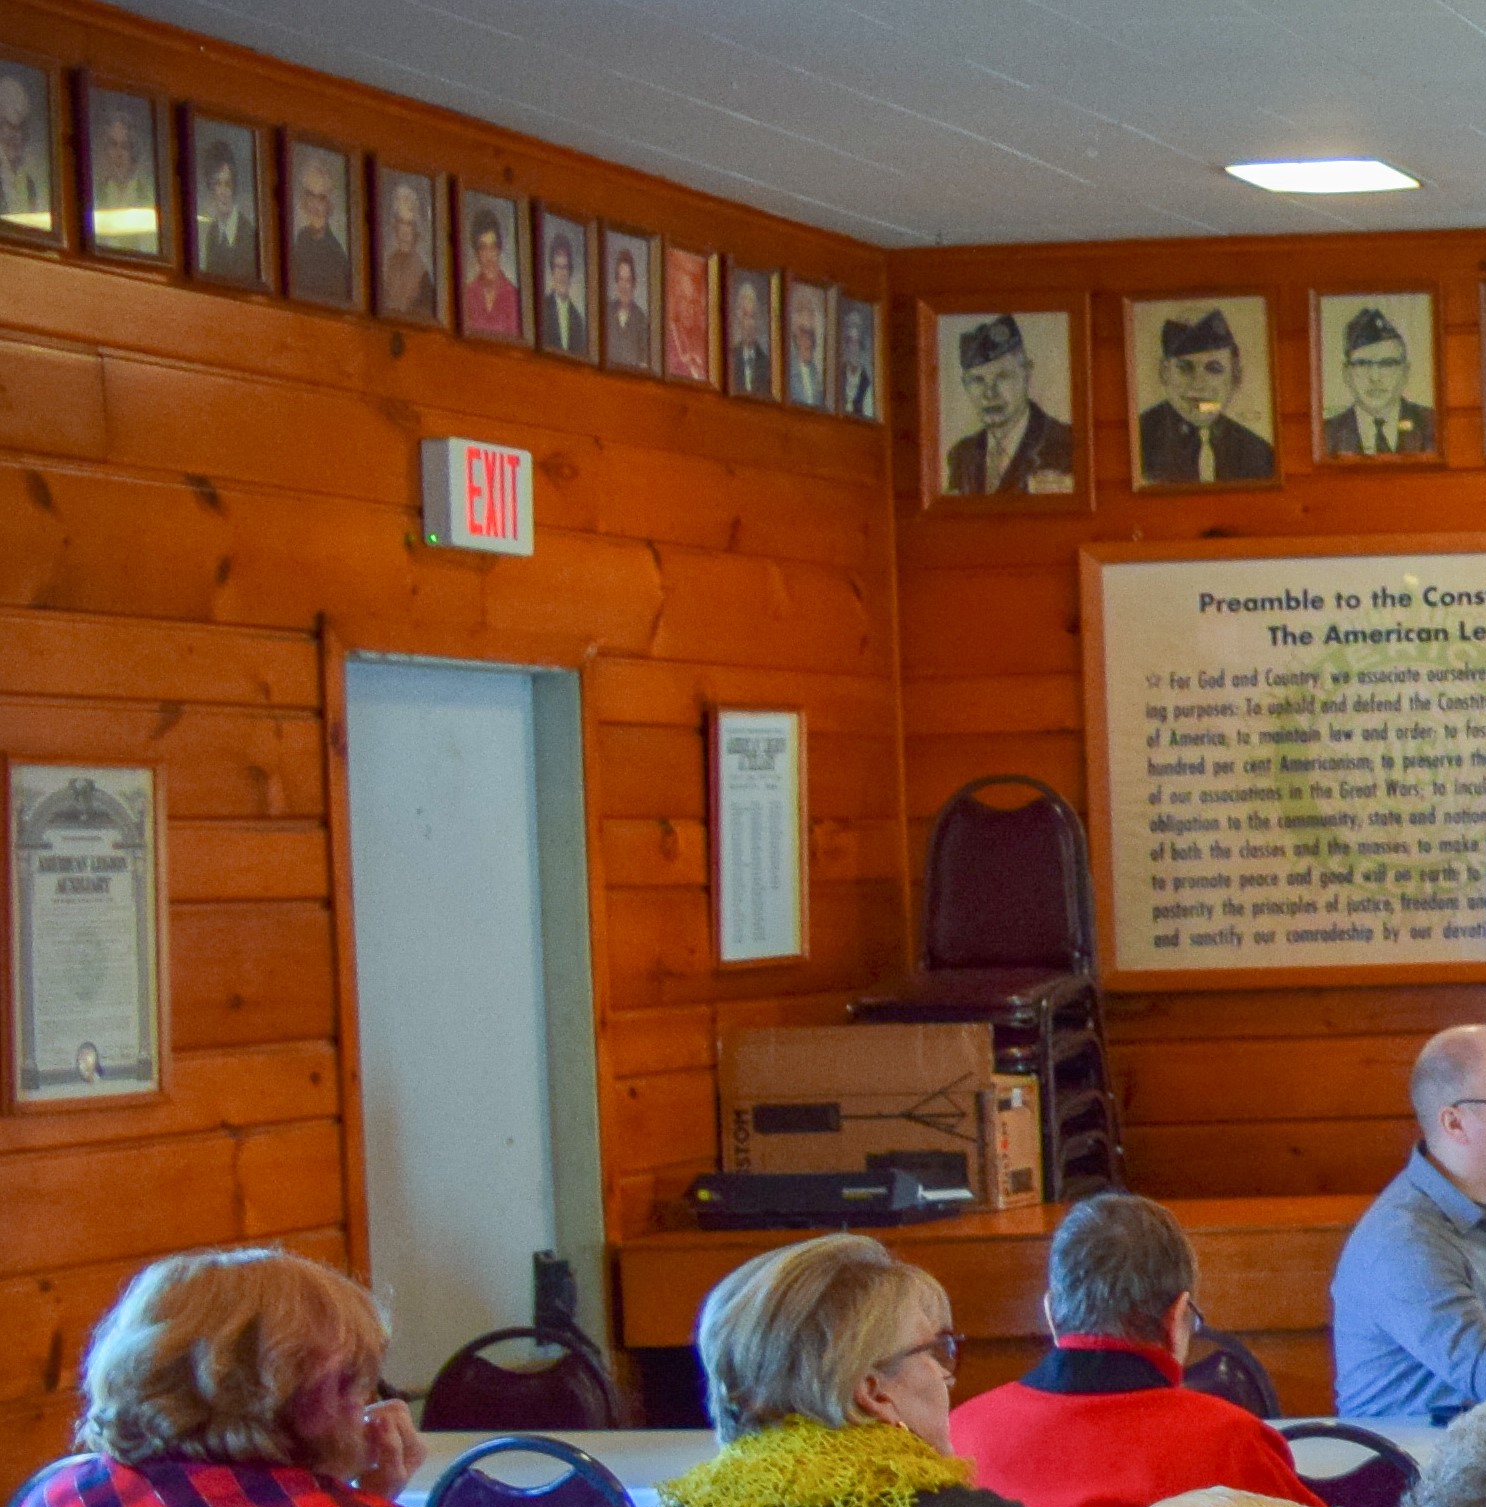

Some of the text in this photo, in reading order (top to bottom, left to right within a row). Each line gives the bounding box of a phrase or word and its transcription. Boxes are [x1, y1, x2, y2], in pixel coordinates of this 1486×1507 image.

[466, 446, 520, 541] EXIT
[1199, 588, 1325, 613] Preamble
[1334, 592, 1361, 609] to
[1371, 586, 1412, 608] the
[1268, 624, 1313, 646] The
[1323, 622, 1449, 645] American
